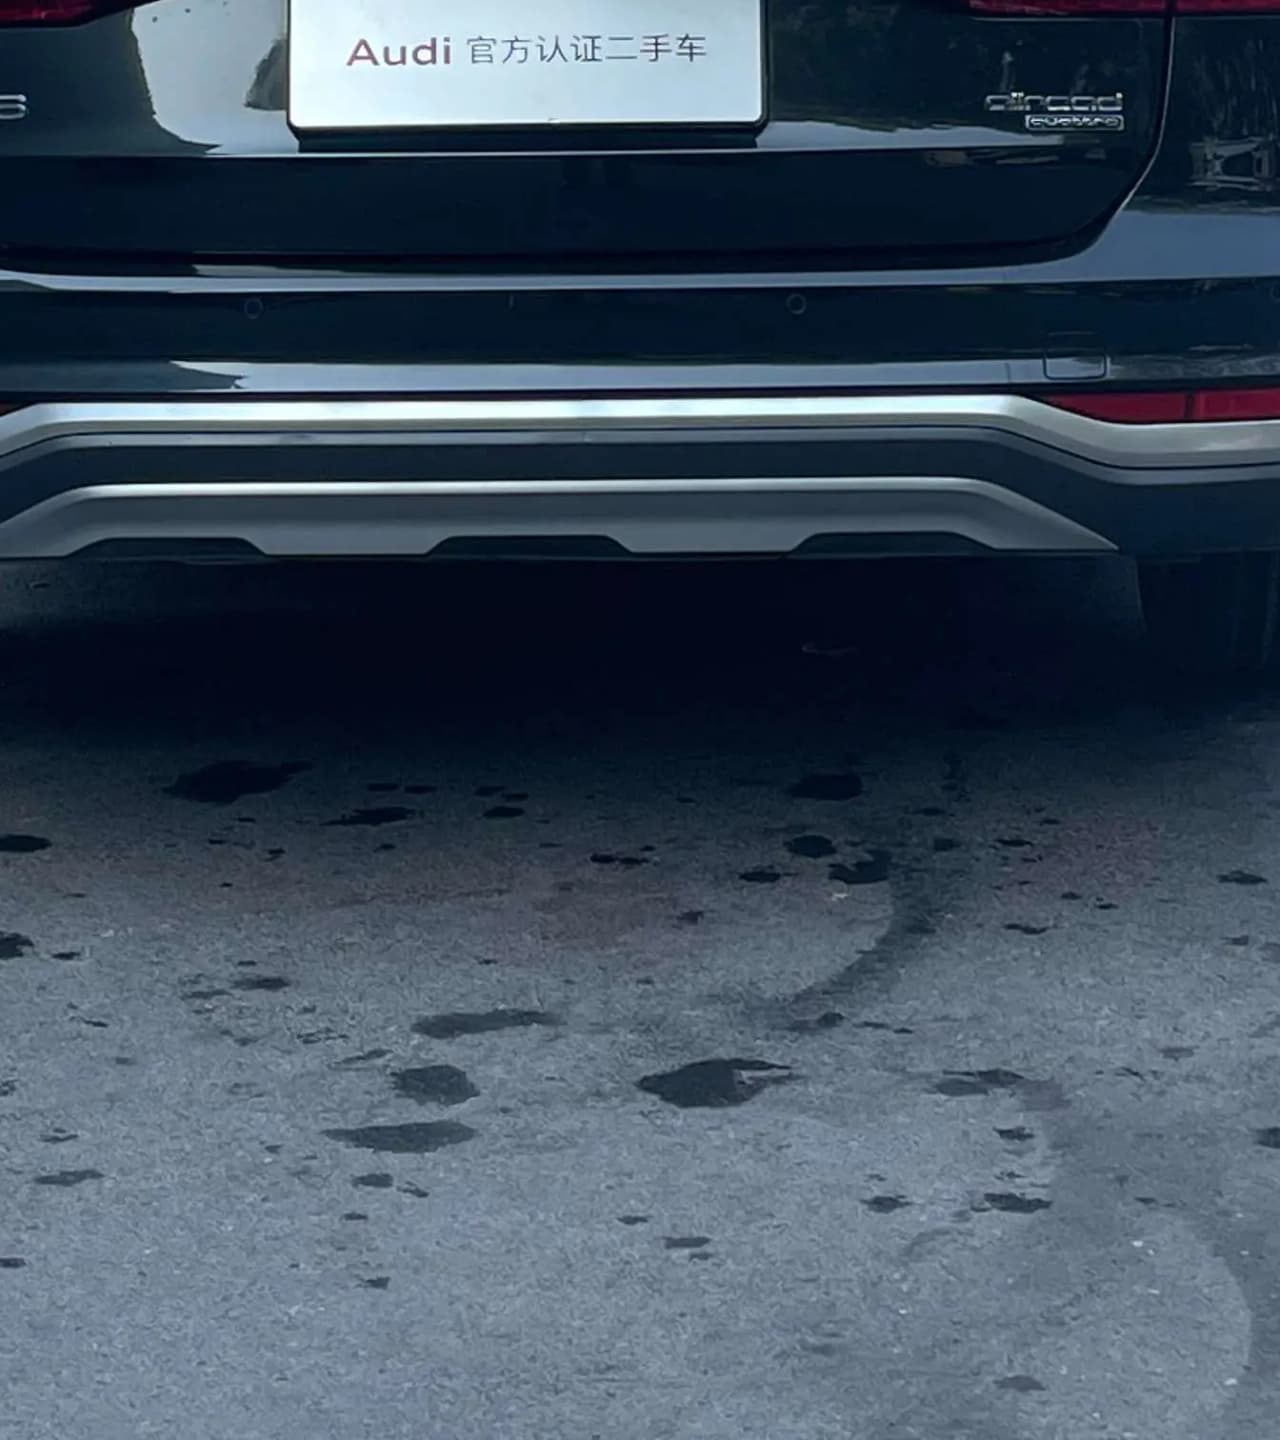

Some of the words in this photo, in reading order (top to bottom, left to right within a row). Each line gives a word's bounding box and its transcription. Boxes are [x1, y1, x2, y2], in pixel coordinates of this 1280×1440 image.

[345, 36, 452, 67] Audi
[466, 32, 707, 64] 官方认证二手车
